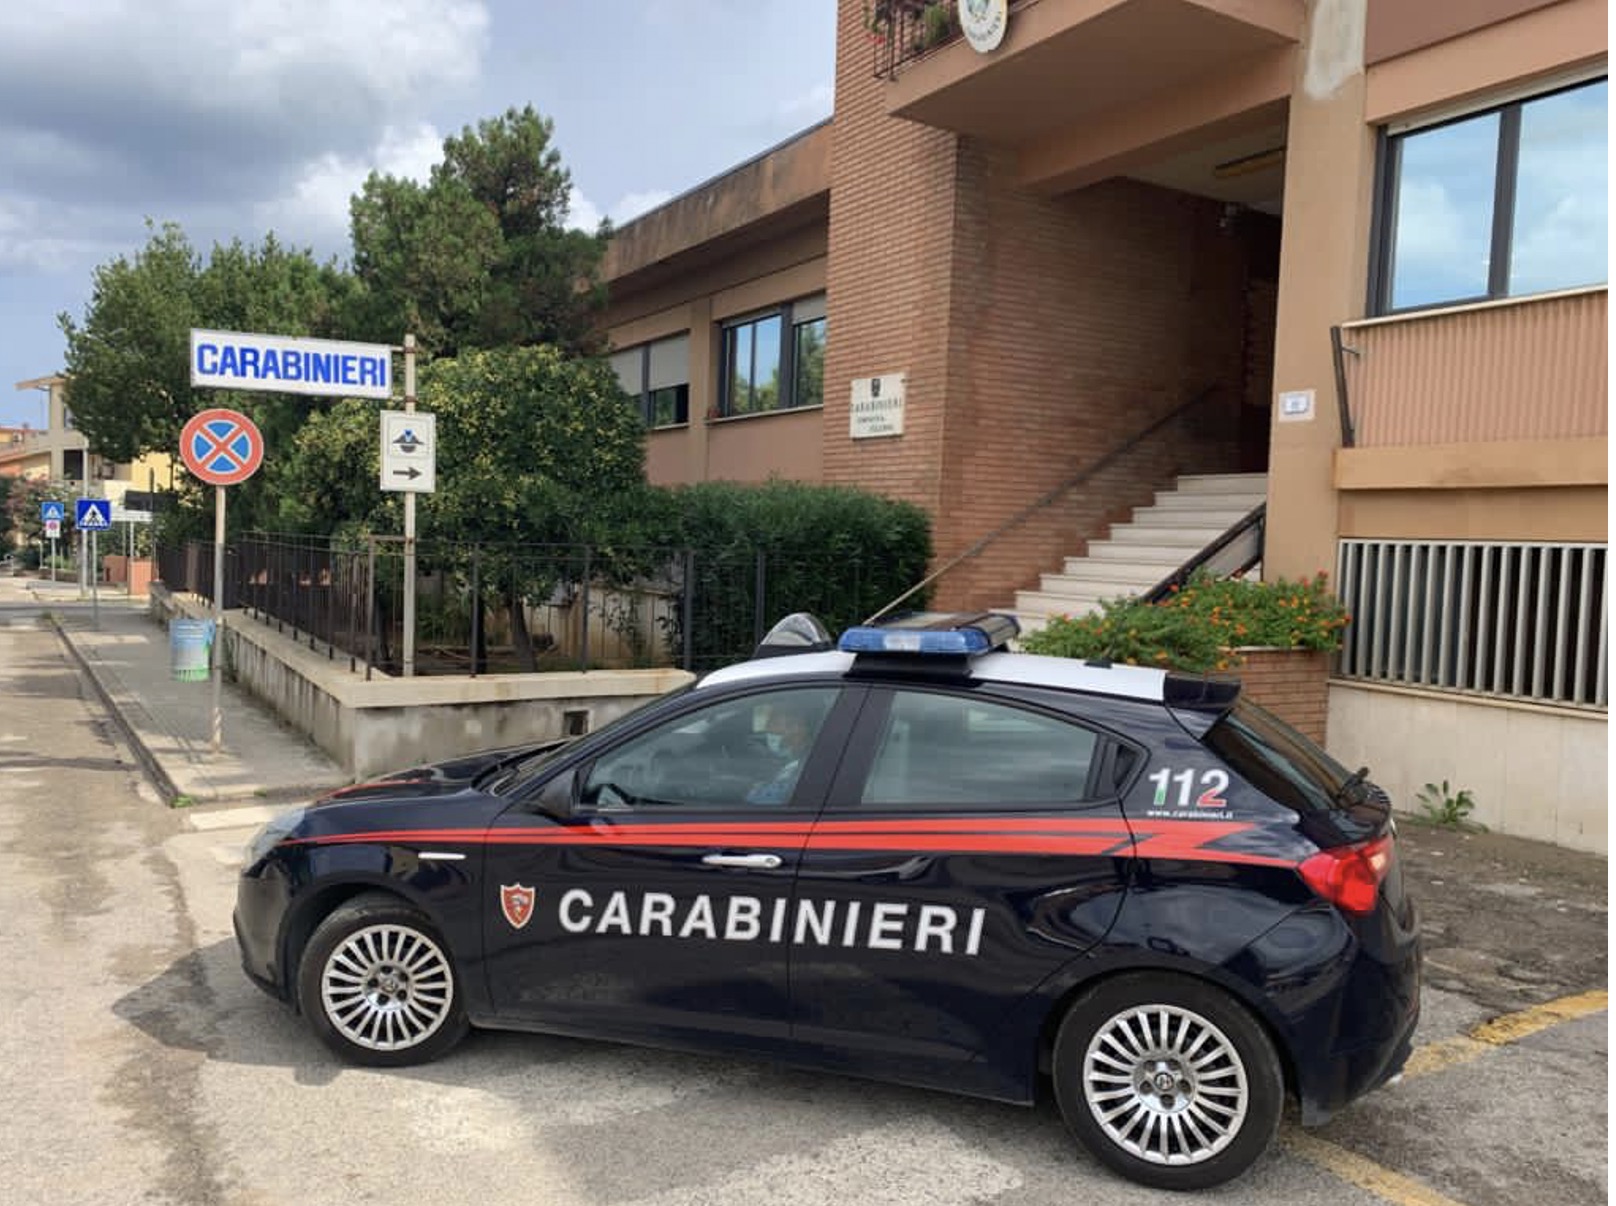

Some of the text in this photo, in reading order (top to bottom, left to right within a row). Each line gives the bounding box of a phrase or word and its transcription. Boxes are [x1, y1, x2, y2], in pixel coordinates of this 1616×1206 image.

[197, 343, 386, 387] CARABINIERI
[1149, 768, 1230, 808] 112
[558, 888, 987, 956] CARABINIERI
